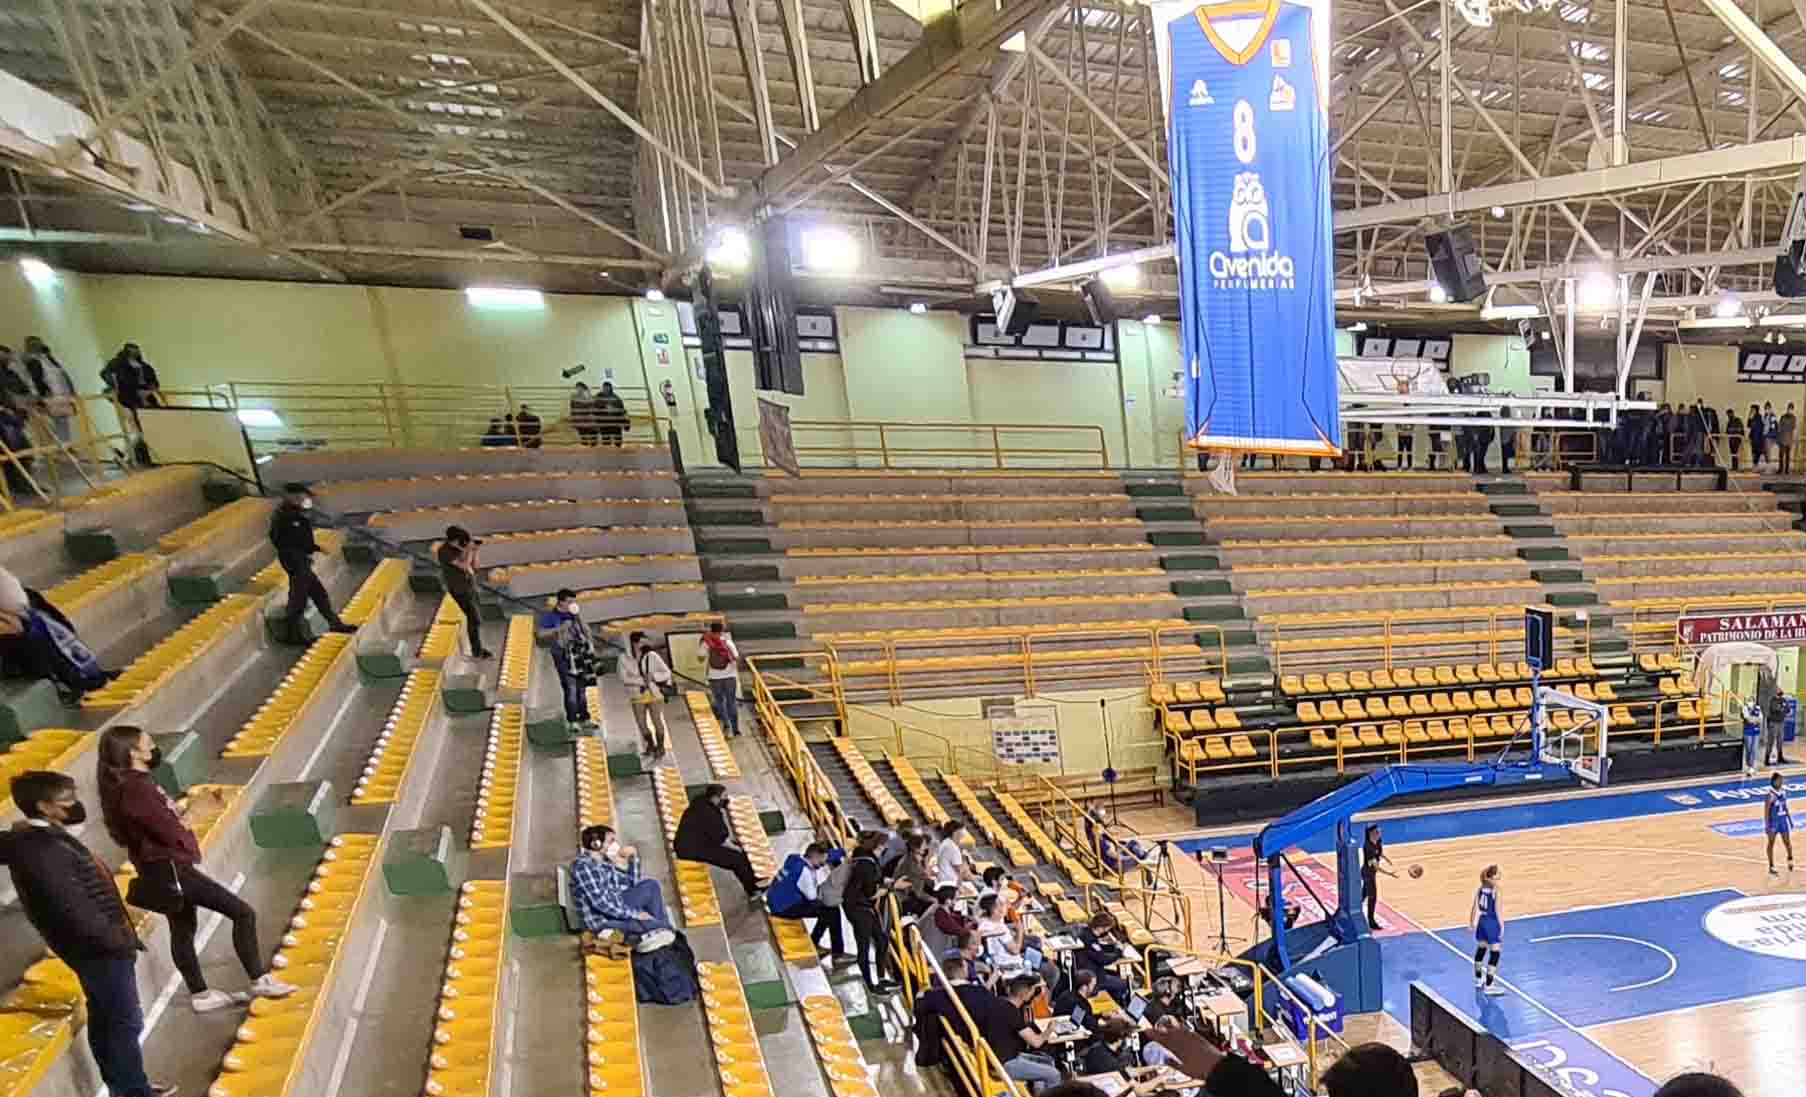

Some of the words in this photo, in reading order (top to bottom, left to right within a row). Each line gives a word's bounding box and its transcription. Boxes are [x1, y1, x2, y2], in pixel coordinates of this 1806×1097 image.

[1232, 99, 1257, 164] 8
[1700, 629, 1763, 643] PATRIMONIO
[1764, 629, 1779, 640] DE
[1780, 628, 1793, 639] LA
